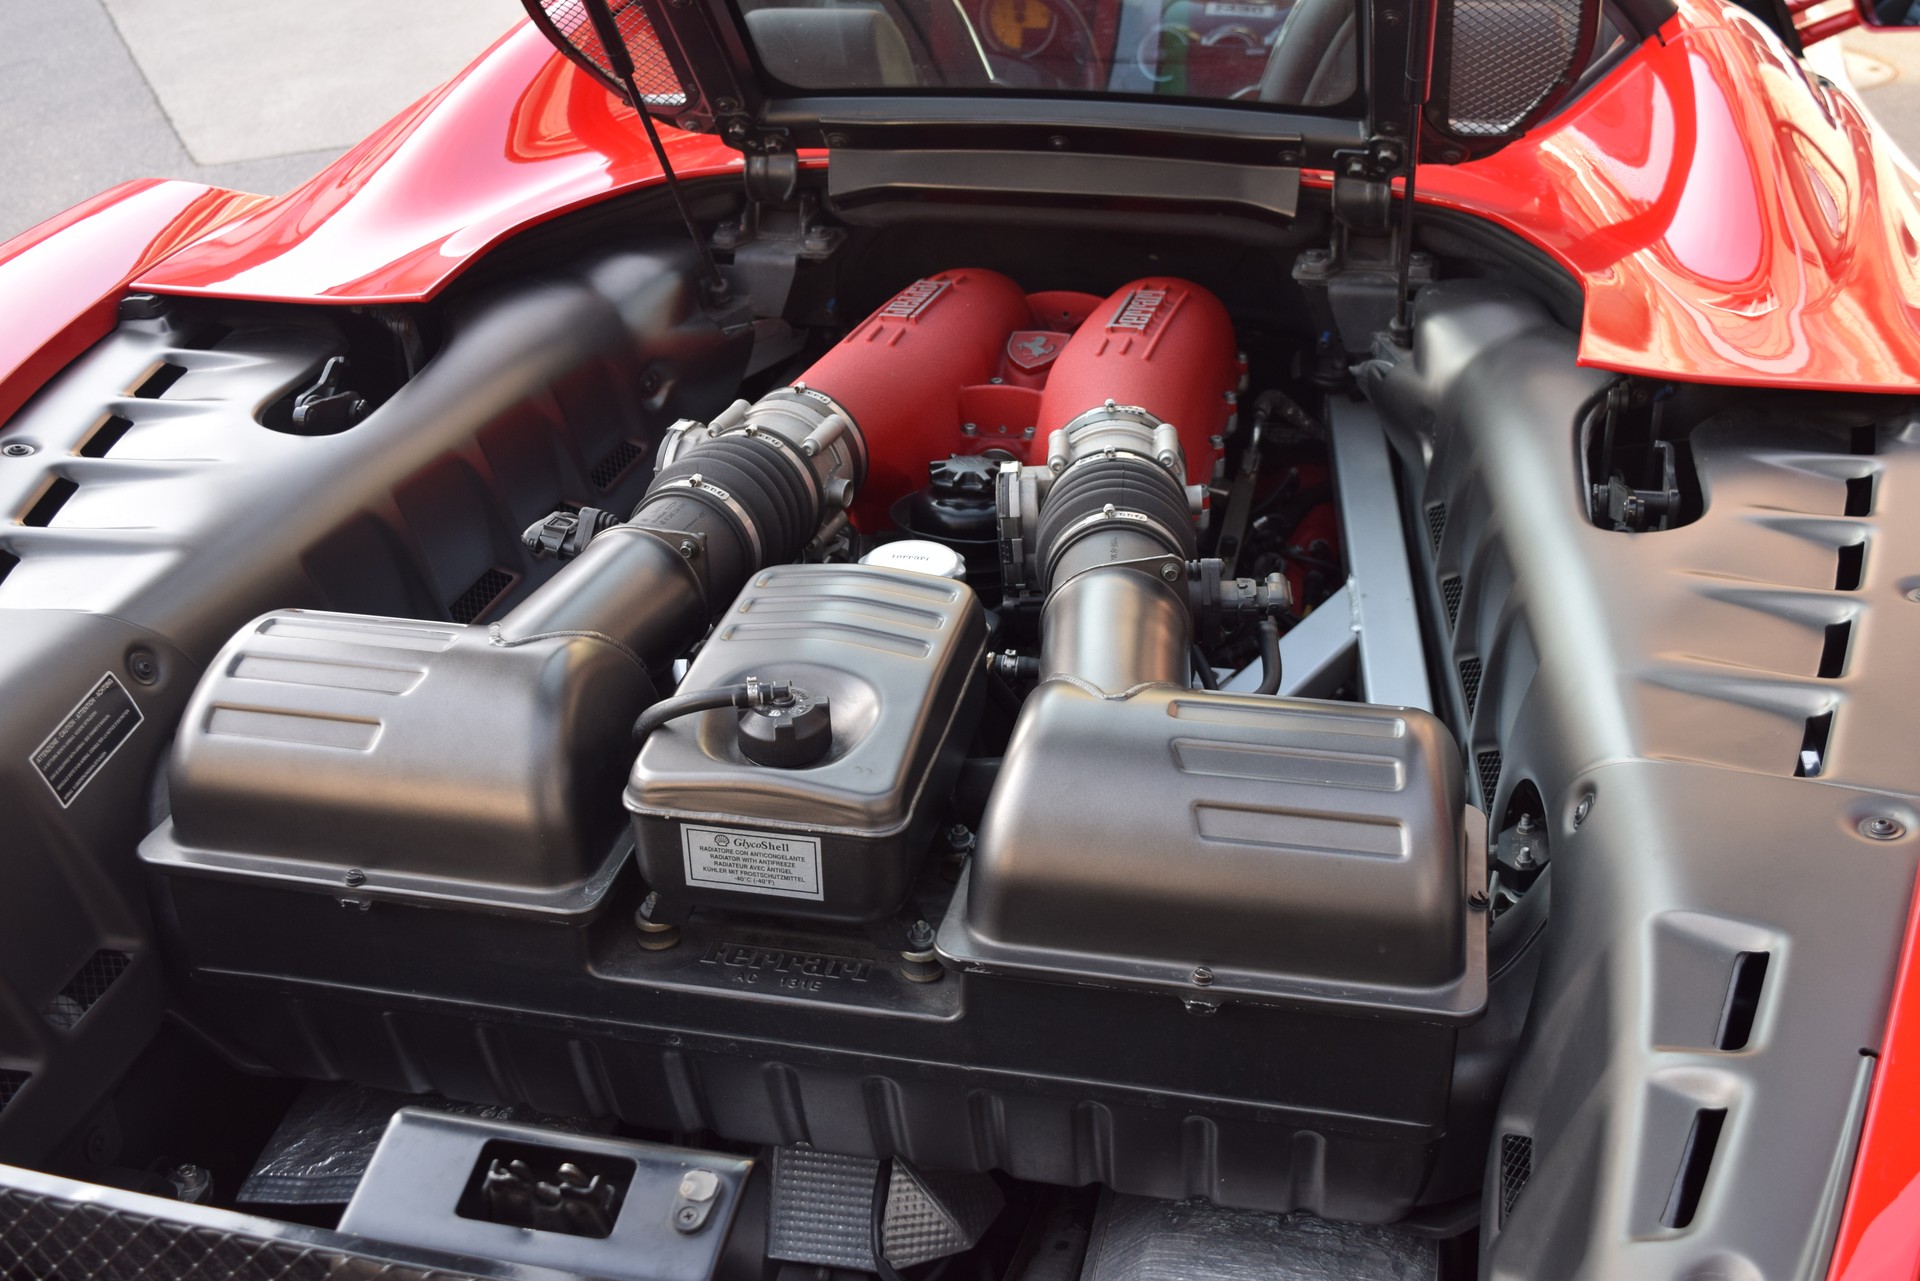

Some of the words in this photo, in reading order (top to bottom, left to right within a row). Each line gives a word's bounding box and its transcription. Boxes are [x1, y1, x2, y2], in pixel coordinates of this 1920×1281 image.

[36, 737, 59, 763] ATTENZIONE
[59, 719, 76, 738] CAUTION
[75, 697, 96, 720] ATTENTION
[95, 677, 113, 698] ACHTUNG
[734, 838, 789, 852] GlycoShell
[699, 846, 733, 854] RADIATORE
[750, 851, 805, 862] ANTICONGELANTE
[710, 854, 740, 862] RADIATOR
[759, 859, 795, 868] ANTIFREEZE
[714, 861, 748, 869] RADIATEUR
[740, 870, 805, 882] FROSTSCHUTZMITTEL
[700, 941, 875, 982] Ferrari
